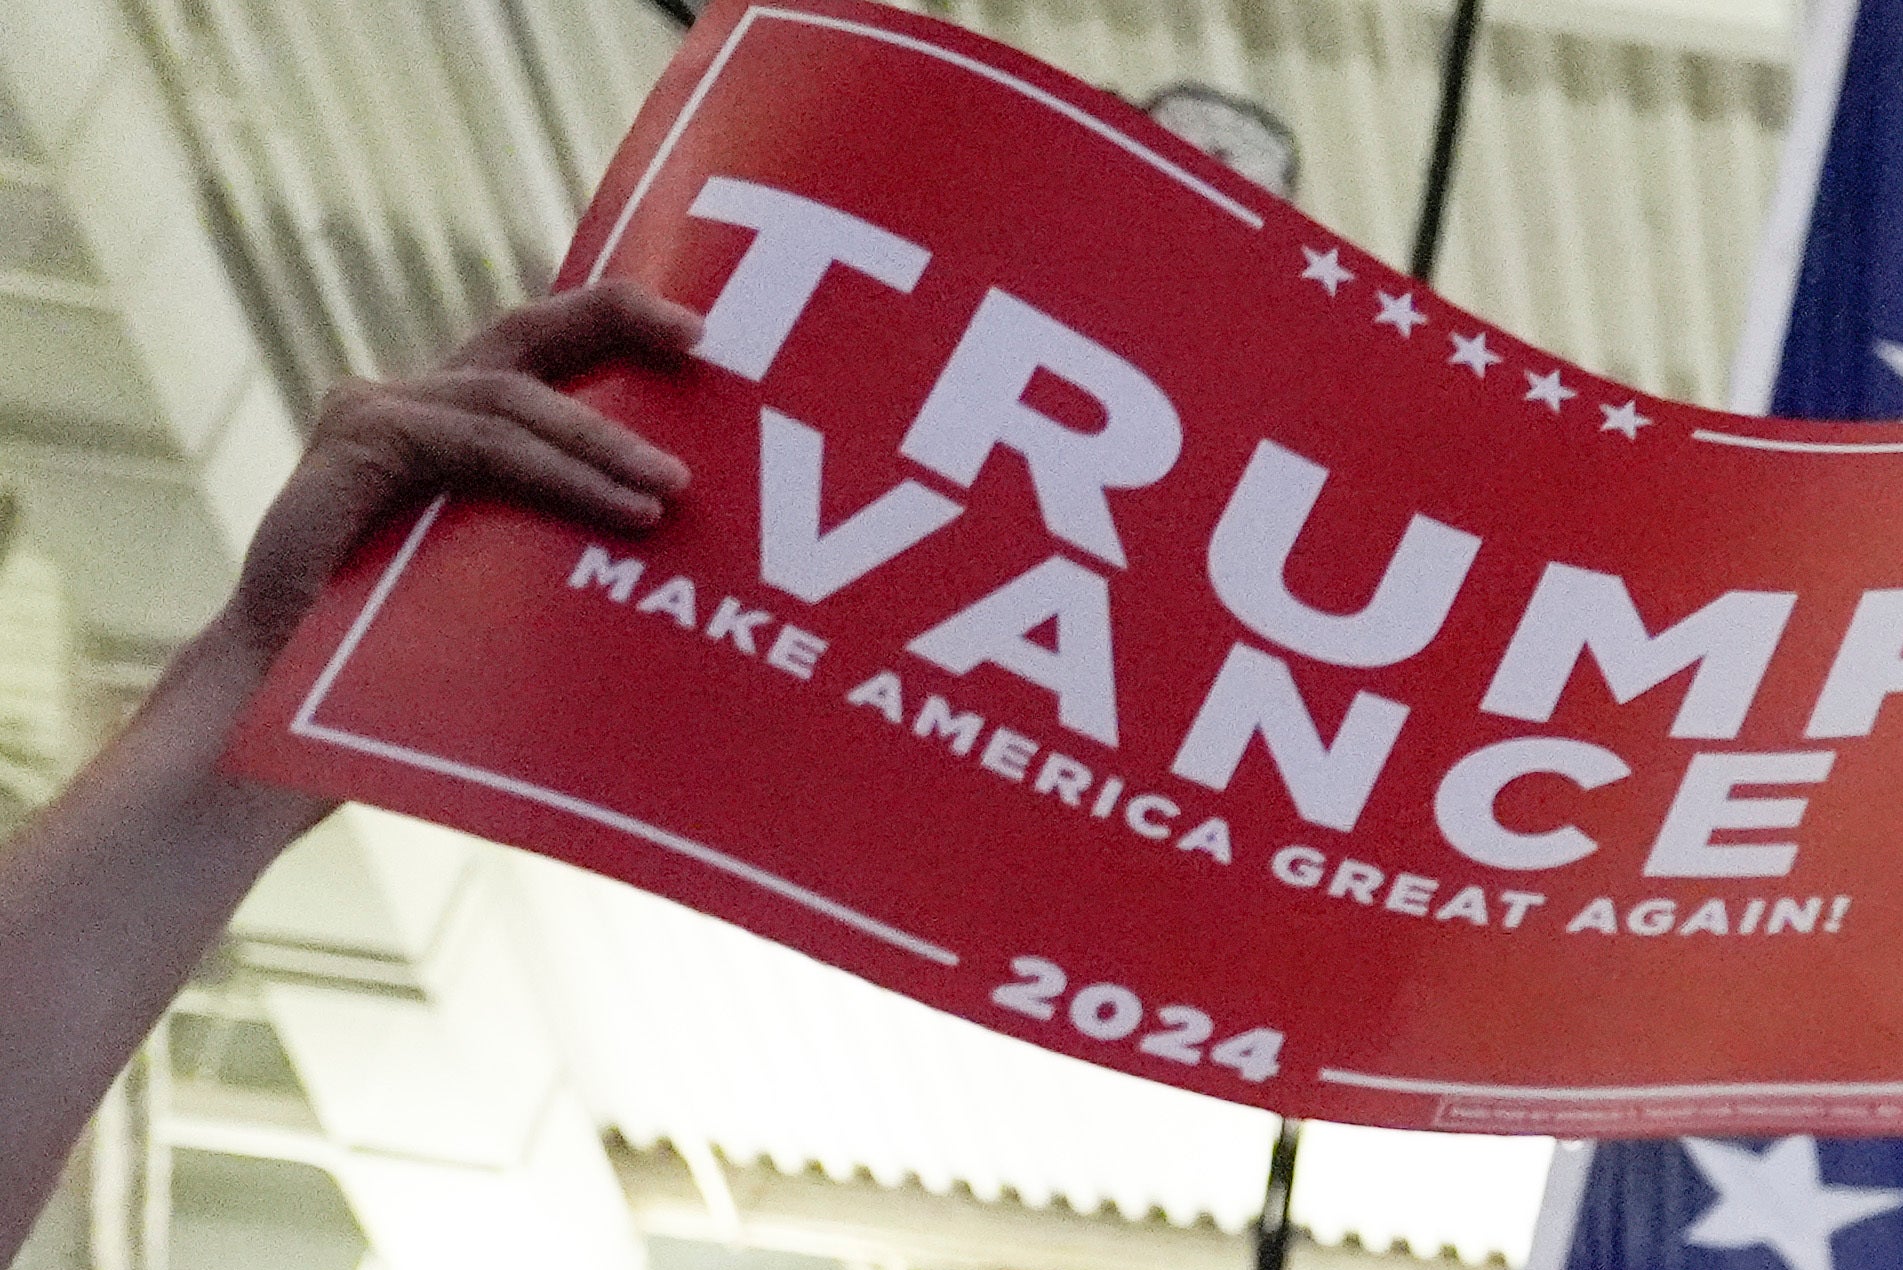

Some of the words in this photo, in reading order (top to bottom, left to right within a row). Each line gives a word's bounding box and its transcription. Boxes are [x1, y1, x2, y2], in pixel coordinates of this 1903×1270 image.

[571, 550, 824, 677] MAKE
[850, 674, 1230, 862] AMERICA
[1273, 847, 1544, 928] GREAT
[1567, 895, 1850, 936] AGAIN!
[762, 409, 1837, 878] VANCE
[993, 958, 1282, 1081] 2024
